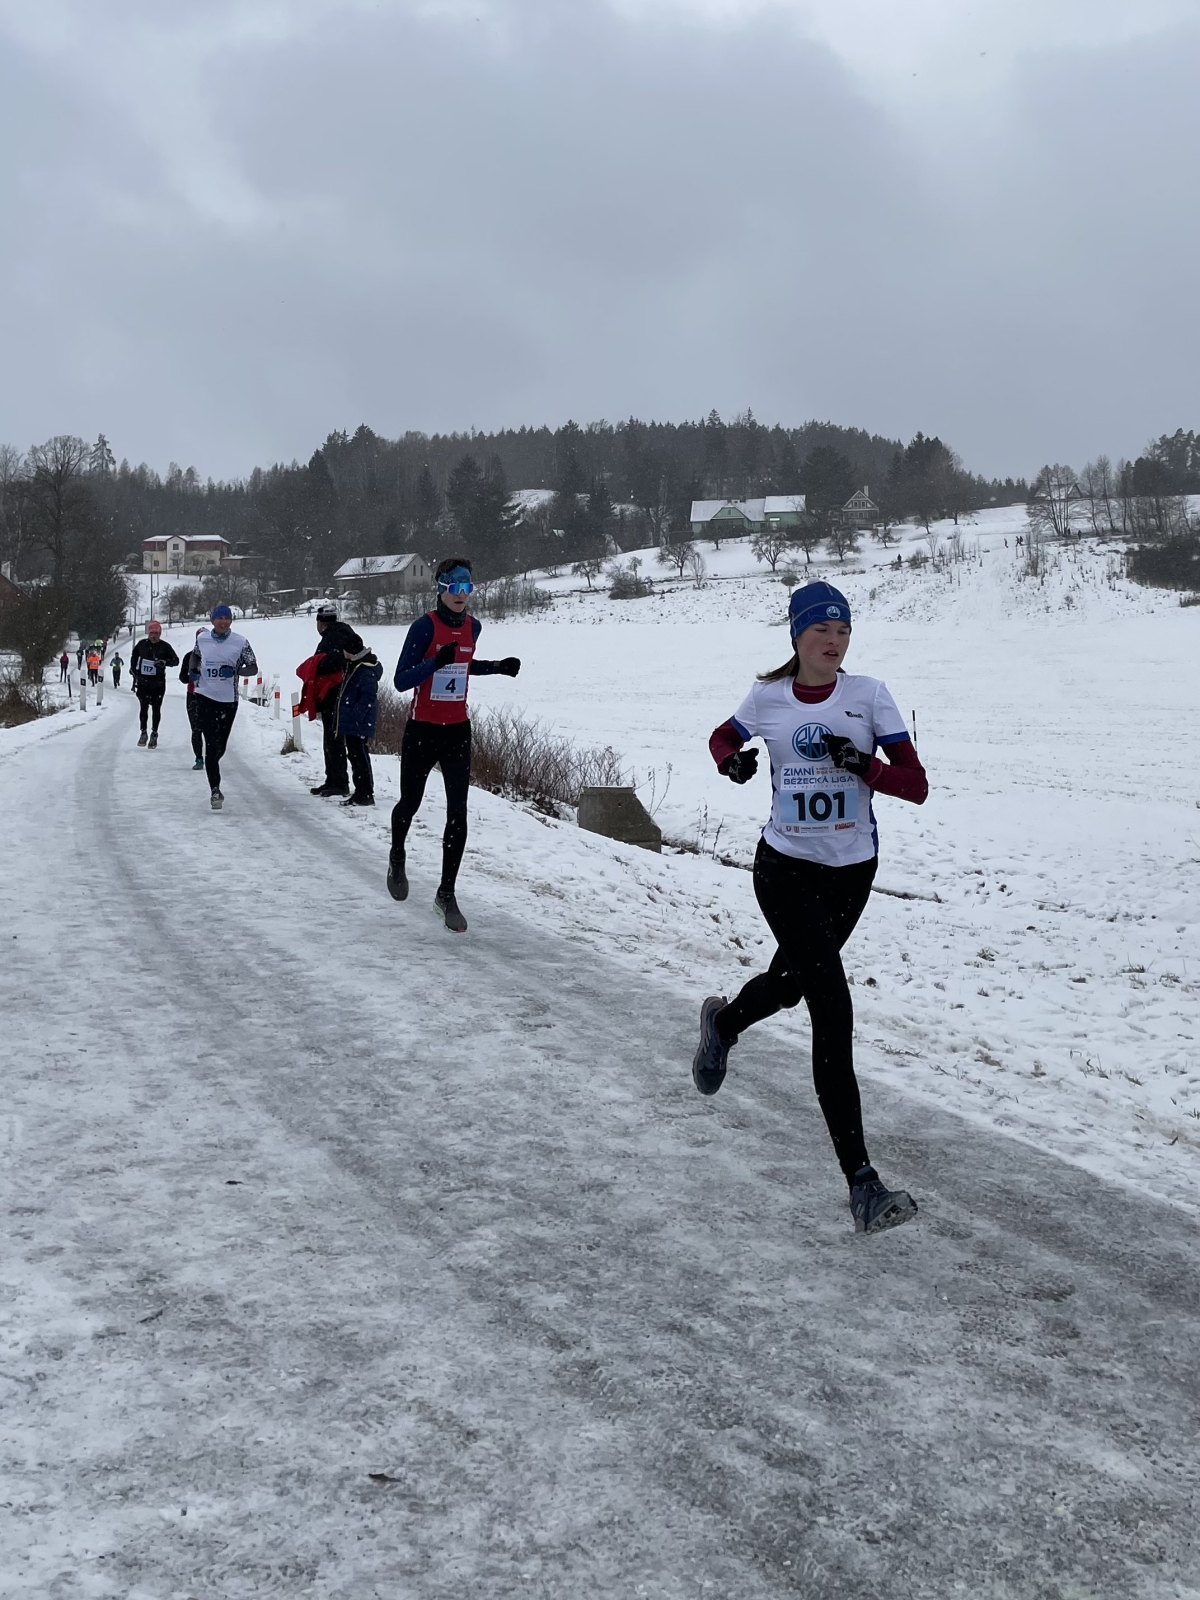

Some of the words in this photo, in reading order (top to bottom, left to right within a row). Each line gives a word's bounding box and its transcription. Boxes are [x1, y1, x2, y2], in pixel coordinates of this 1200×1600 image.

[445, 678, 456, 694] 4
[783, 766, 815, 777] ZIMNÍ
[831, 775, 855, 783] LIGA
[792, 791, 845, 822] 101
